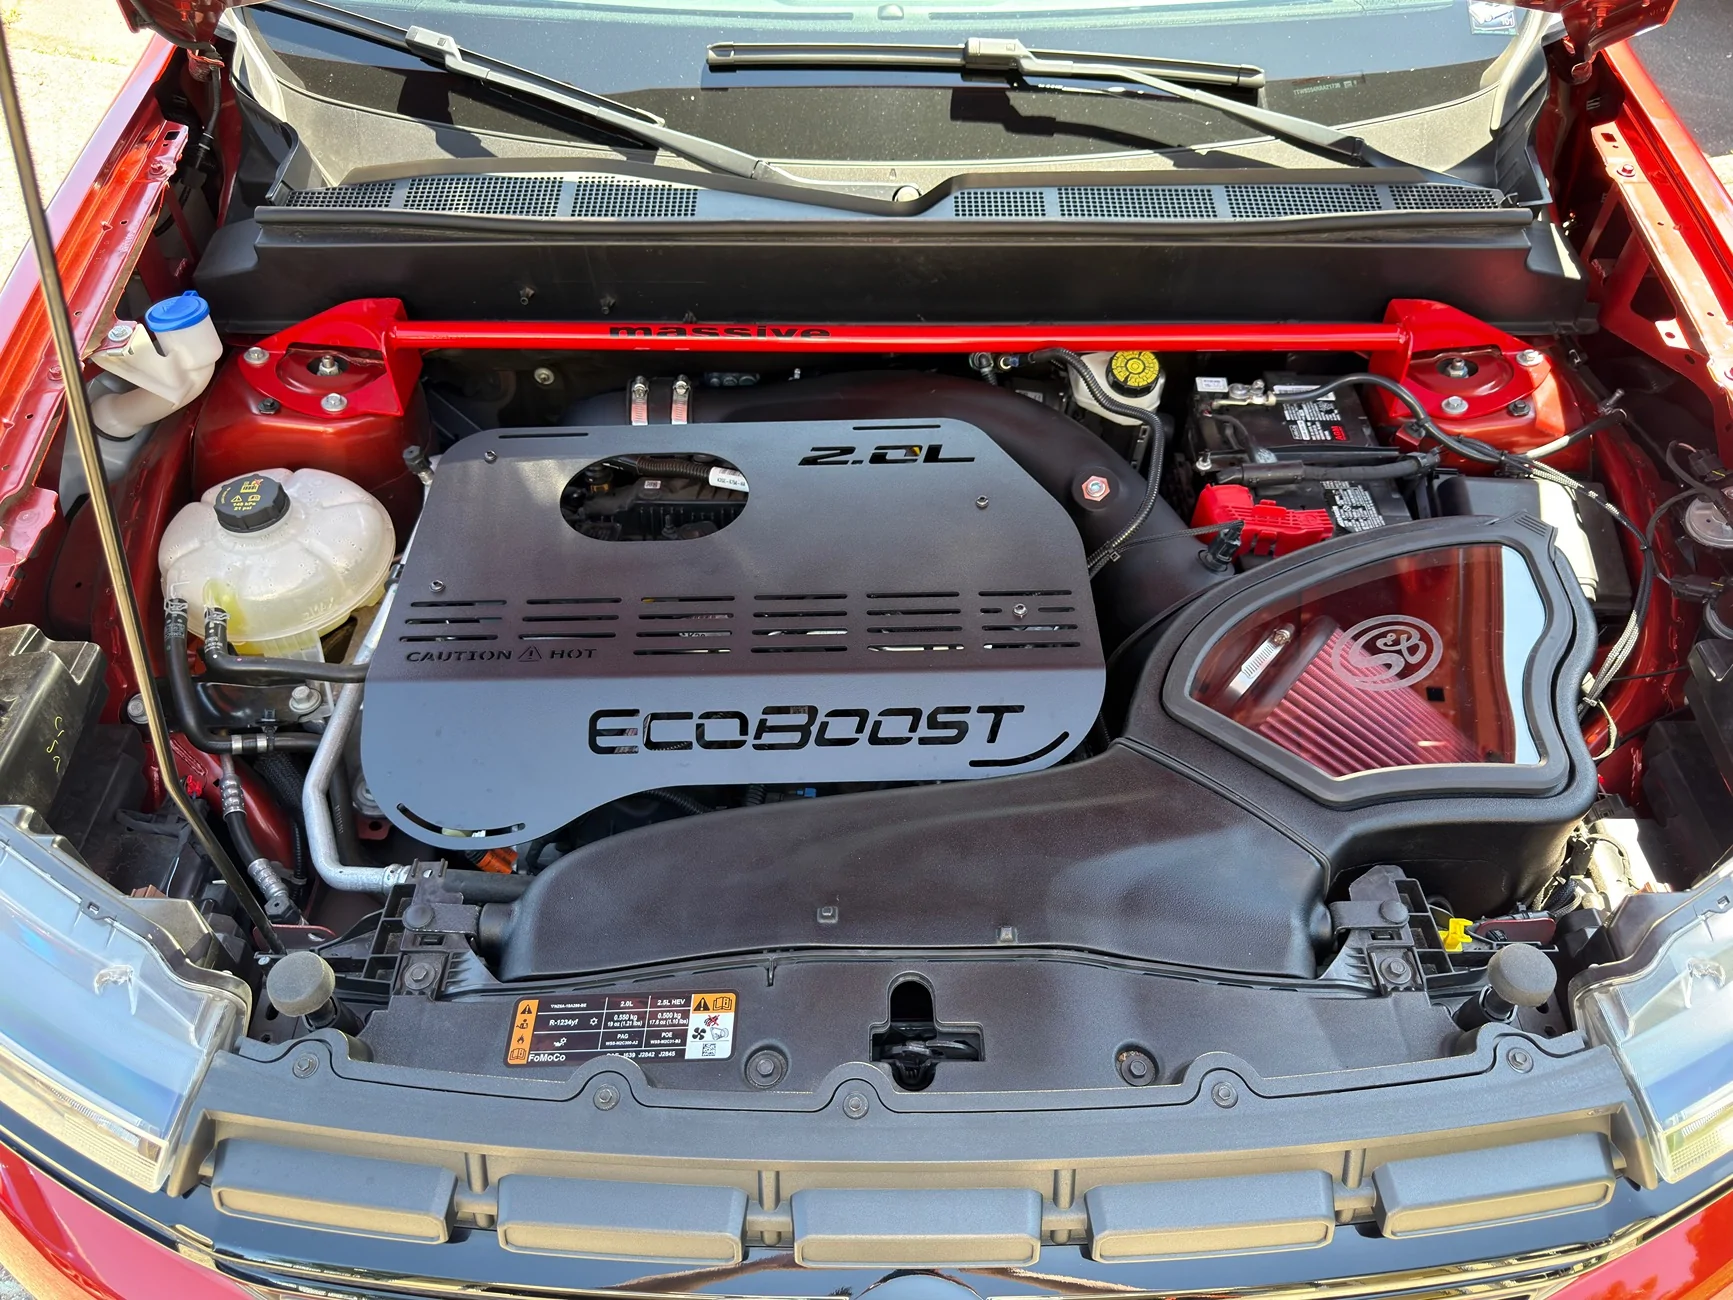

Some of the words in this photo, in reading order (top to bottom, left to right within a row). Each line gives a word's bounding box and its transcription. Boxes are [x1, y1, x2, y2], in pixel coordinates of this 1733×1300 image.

[609, 325, 831, 339] massive
[798, 444, 975, 466] 2.0L
[406, 650, 512, 662] CAUTION
[550, 648, 597, 659] HOT
[549, 1018, 579, 1027] R-1234yf
[528, 1053, 566, 1062] FoMoCo
